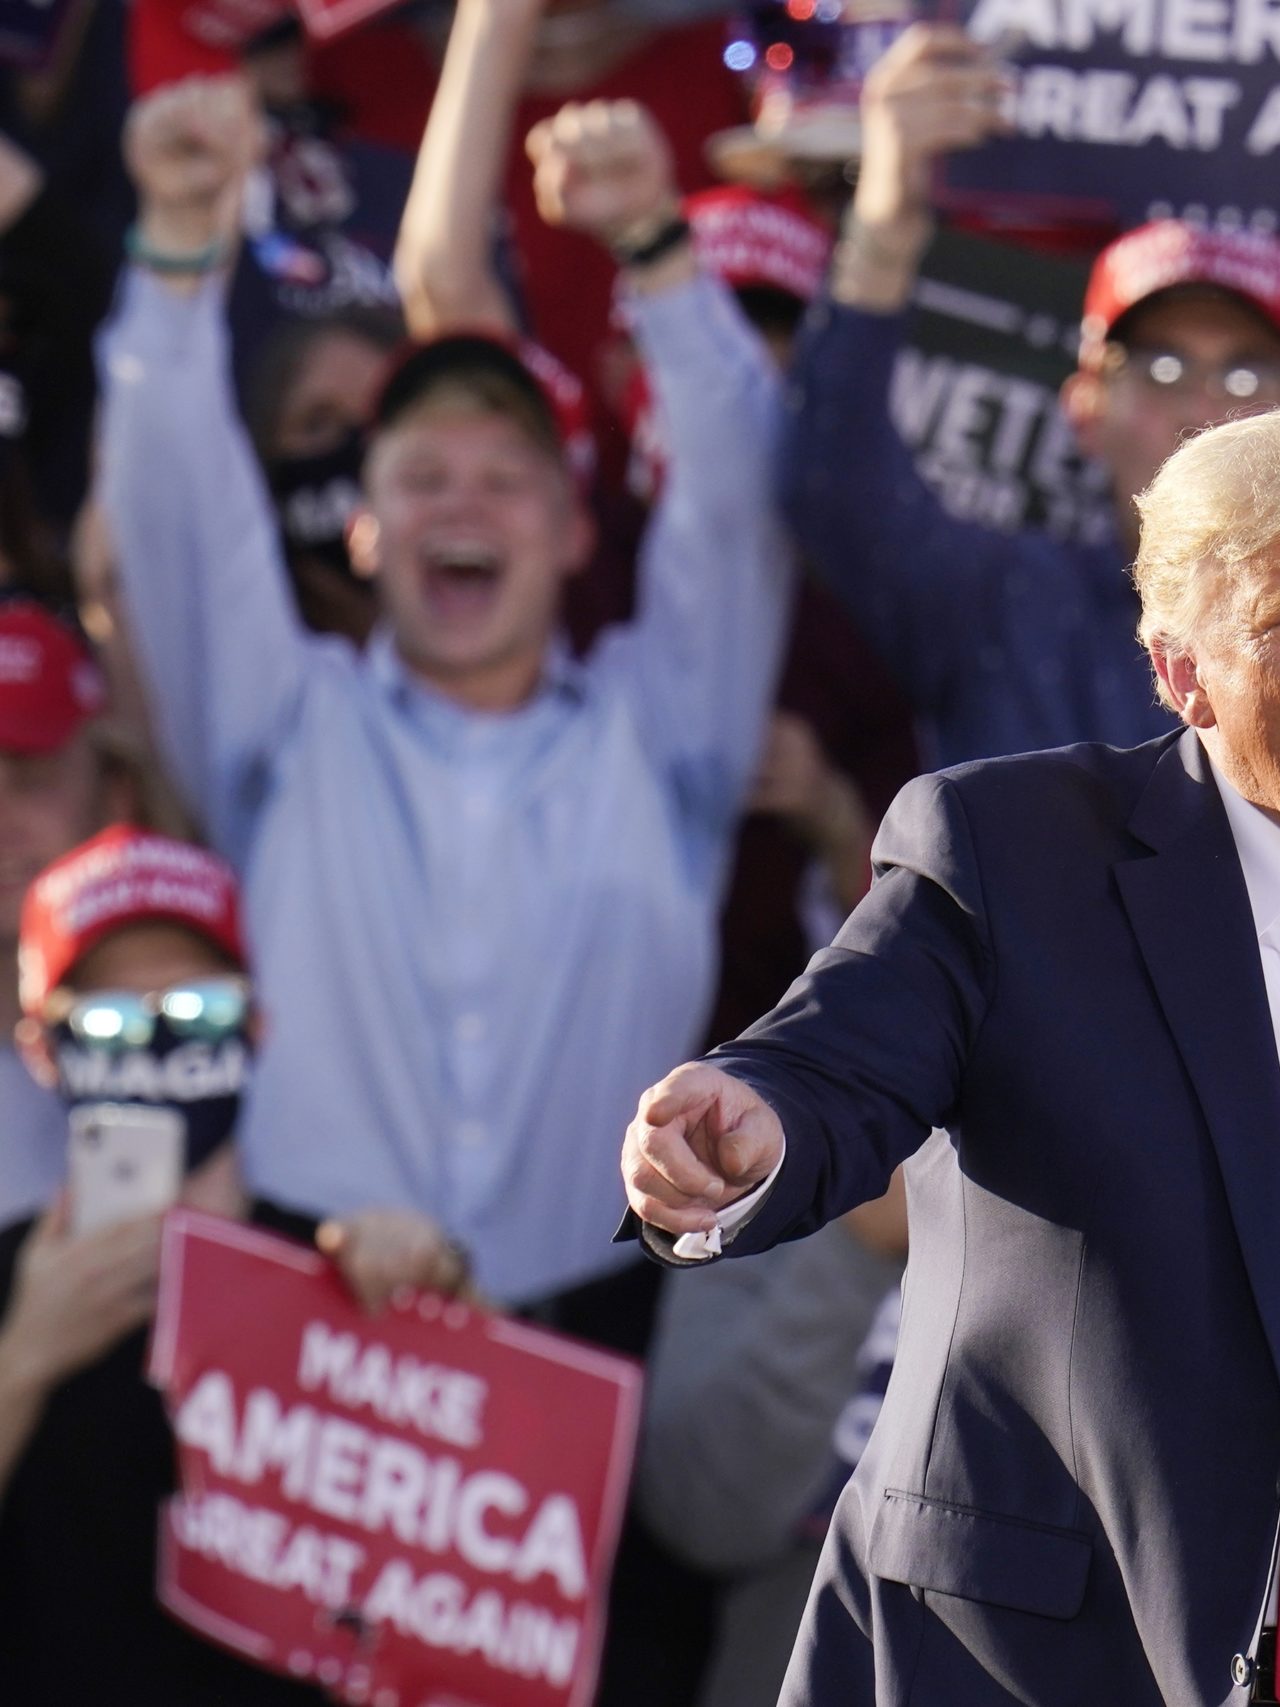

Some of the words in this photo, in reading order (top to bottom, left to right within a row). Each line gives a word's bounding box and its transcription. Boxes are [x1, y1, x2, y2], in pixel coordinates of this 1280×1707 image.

[998, 64, 1240, 151] REAT
[298, 1320, 488, 1450] MAKE
[176, 1366, 592, 1602] AMERICA
[361, 1558, 580, 1690] AGAIN
